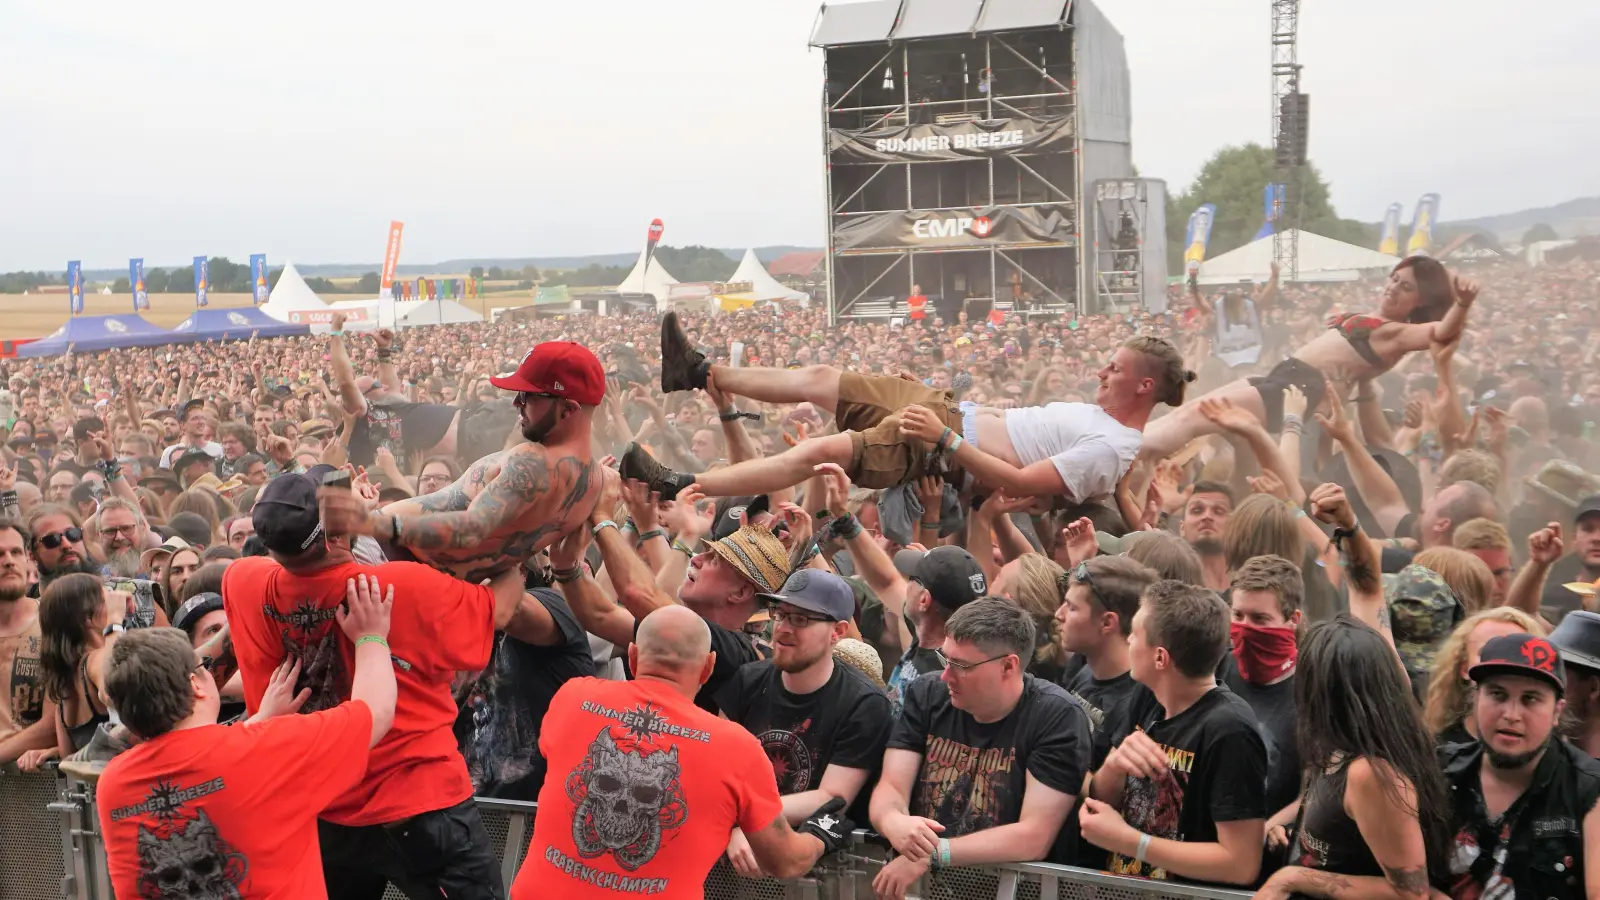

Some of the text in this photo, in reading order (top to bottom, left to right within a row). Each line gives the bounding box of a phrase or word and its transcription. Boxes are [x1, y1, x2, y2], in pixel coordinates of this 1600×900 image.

[876, 129, 1023, 153] SUMMER BREEZE
[912, 218, 973, 238] EMP
[581, 700, 711, 744] SUMMER BREEZE
[111, 777, 226, 822] SUMMER BREEZE
[544, 844, 669, 895] GRABENSCHLAMPEN
